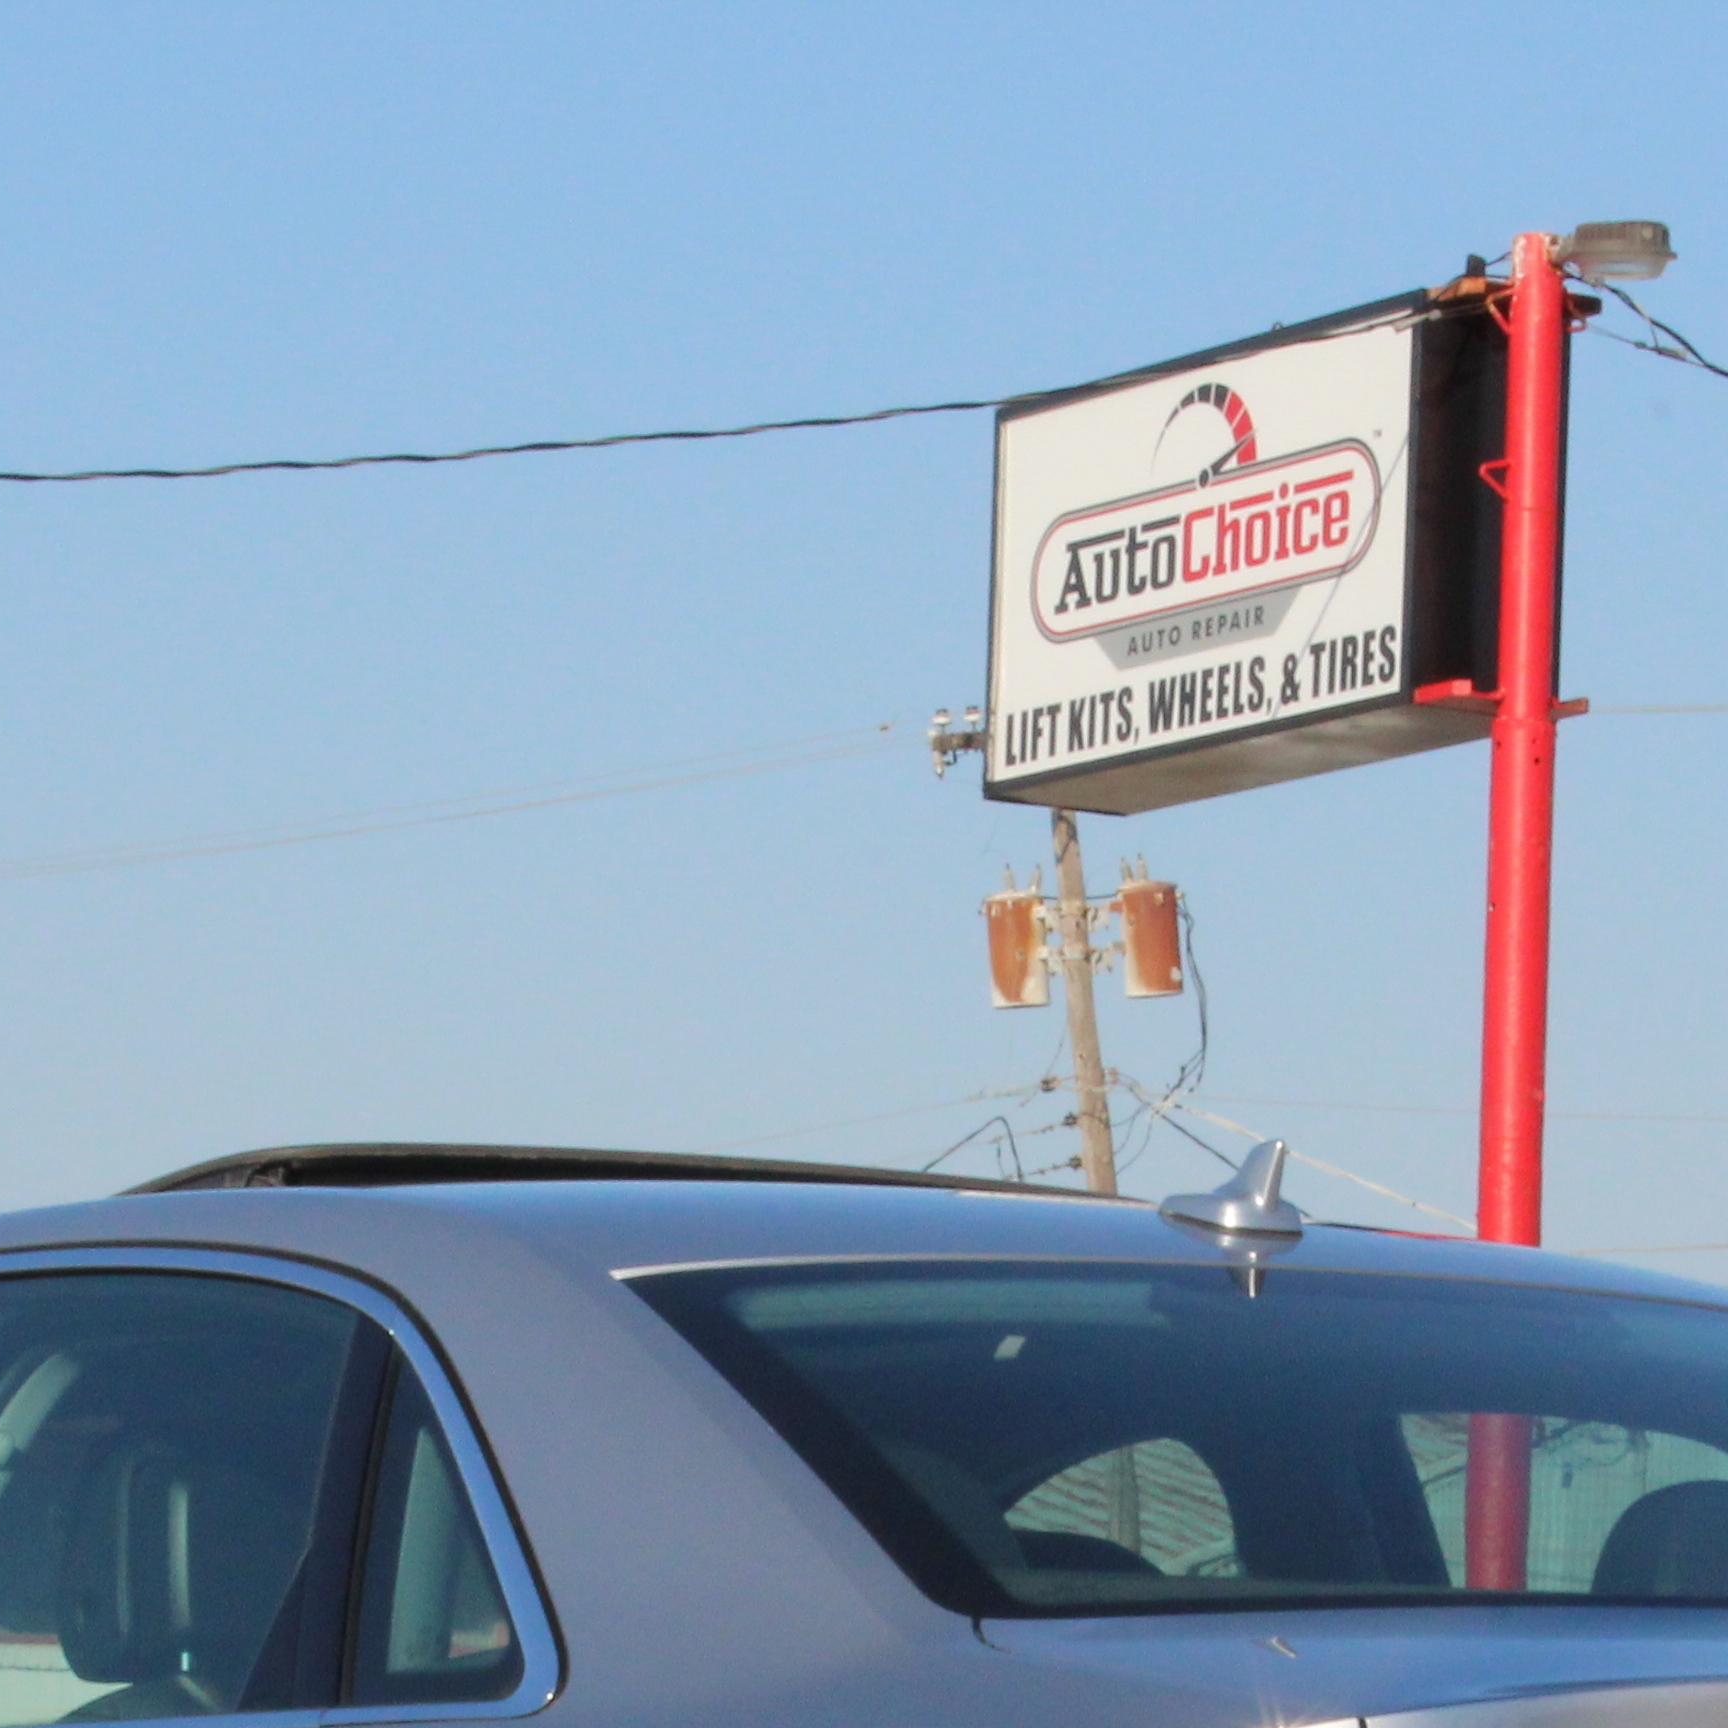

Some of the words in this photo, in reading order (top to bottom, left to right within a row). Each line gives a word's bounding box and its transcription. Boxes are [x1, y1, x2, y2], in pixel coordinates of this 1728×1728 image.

[1126, 626, 1183, 657] AUTO
[1190, 604, 1266, 641] REPAIR
[1004, 703, 1063, 767] LIFT
[1067, 686, 1140, 752] KITS,
[1147, 655, 1273, 736] WHEELS,
[1280, 652, 1302, 705] &
[1308, 624, 1397, 699] TIRES
